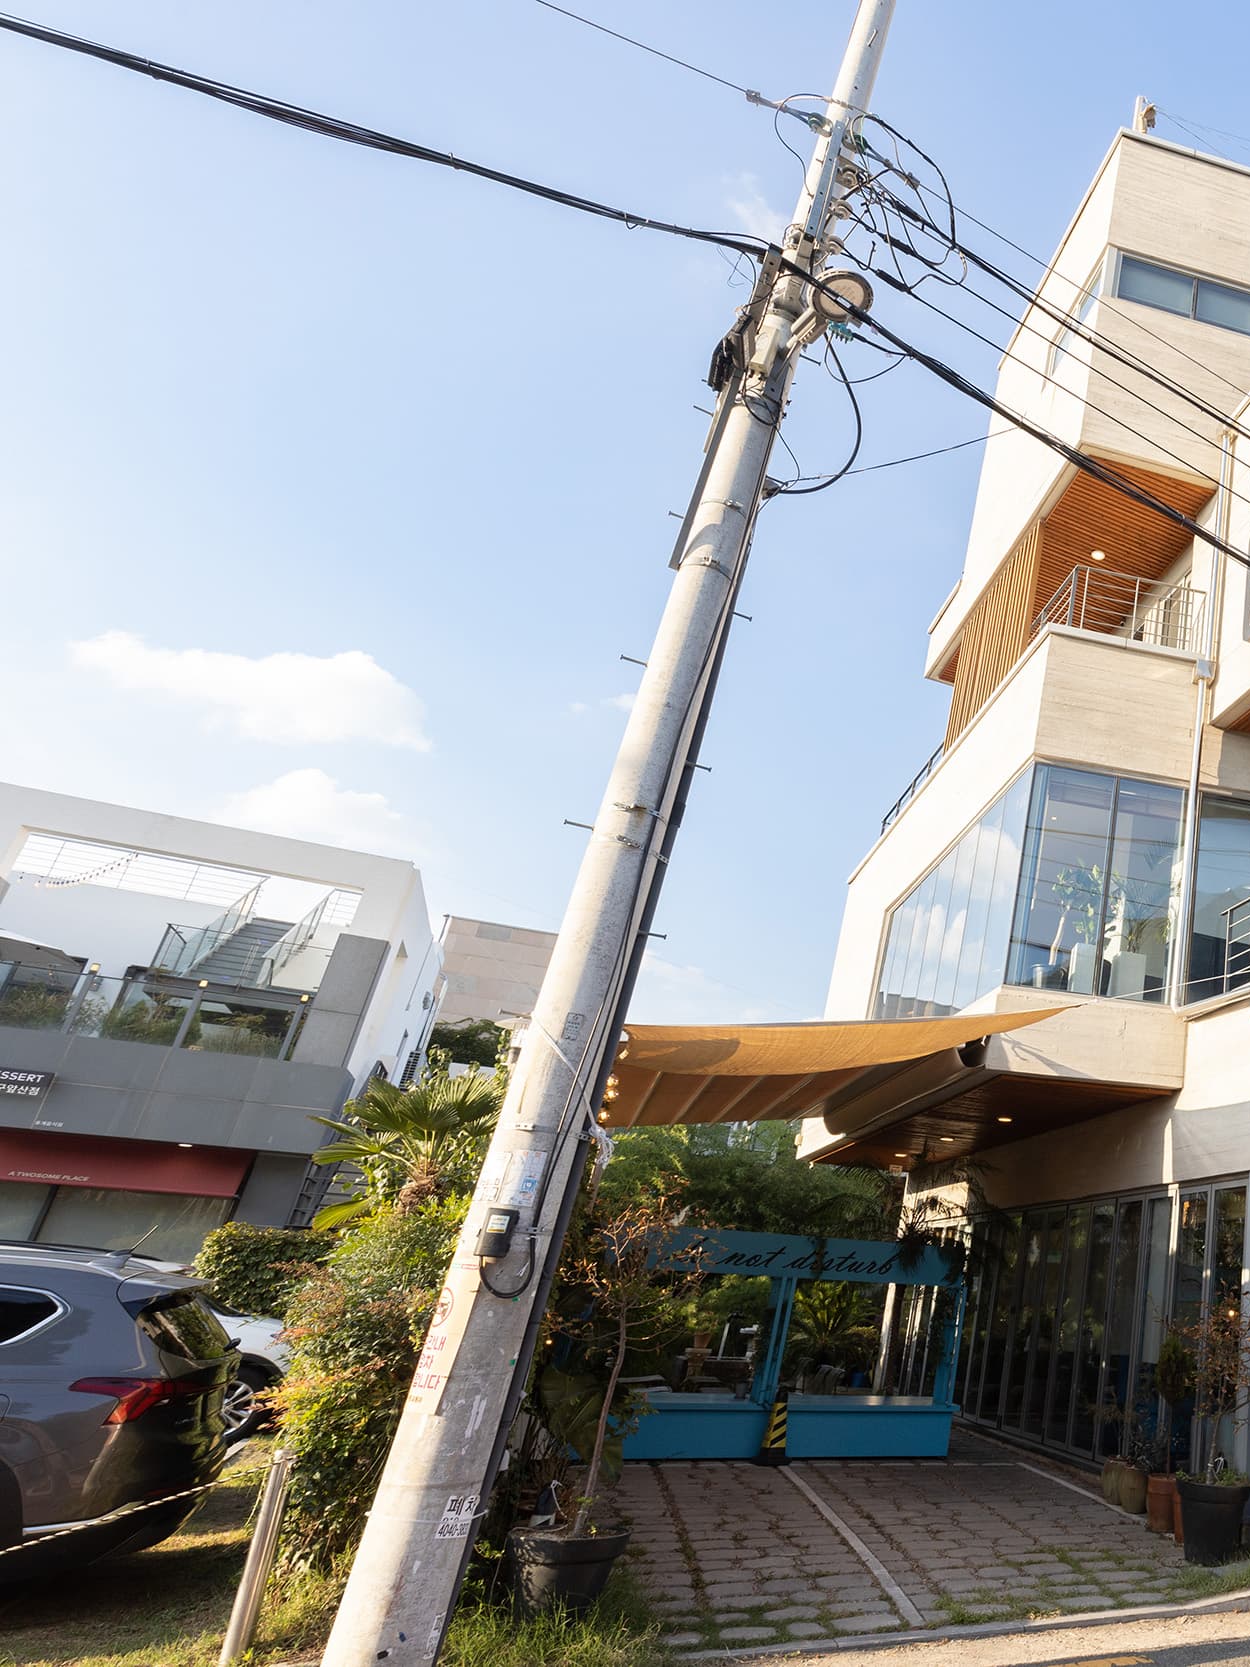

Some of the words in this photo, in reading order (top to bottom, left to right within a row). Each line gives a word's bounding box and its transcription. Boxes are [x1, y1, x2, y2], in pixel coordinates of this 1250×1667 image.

[0, 1070, 45, 1083] SSERT
[62, 1174, 90, 1182] PLACE
[716, 1246, 787, 1268] not
